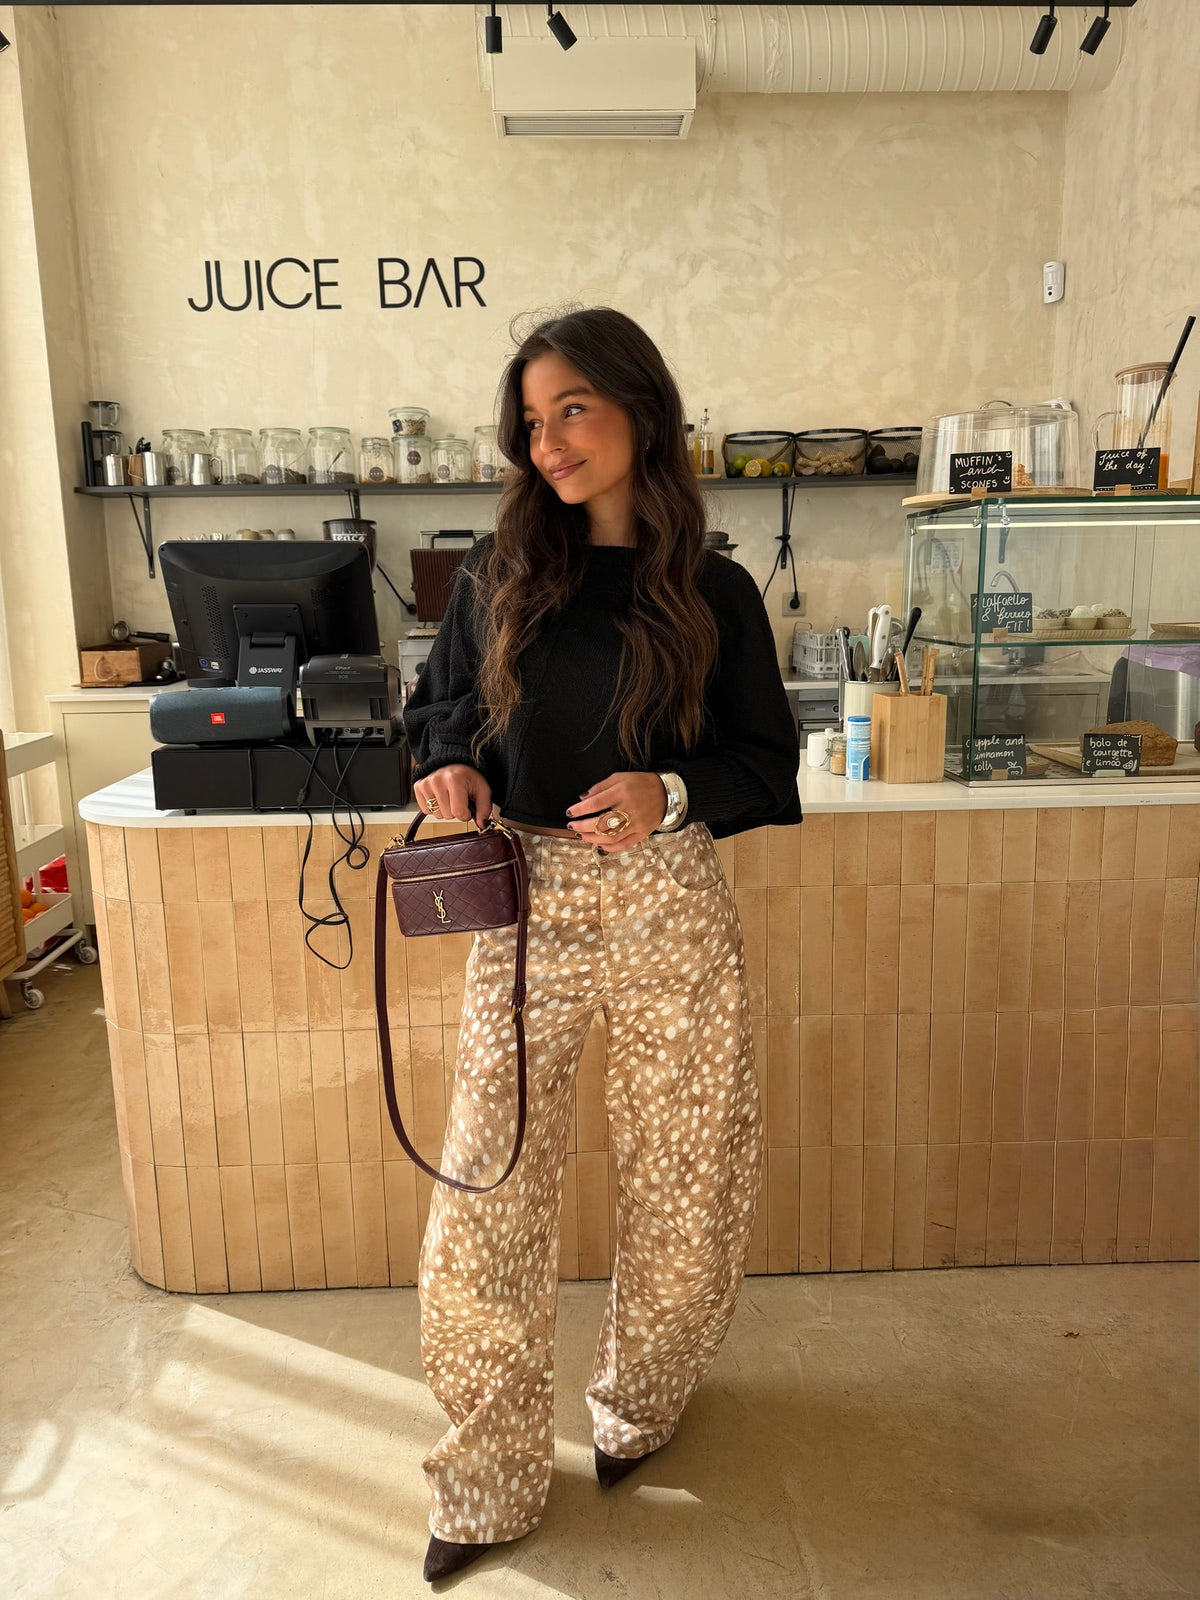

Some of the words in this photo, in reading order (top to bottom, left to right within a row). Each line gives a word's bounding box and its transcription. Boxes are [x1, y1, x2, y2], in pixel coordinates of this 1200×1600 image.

[187, 257, 342, 312] JUICE
[377, 256, 487, 309] BAR
[1099, 450, 1130, 466] juice
[1136, 449, 1148, 459] of
[960, 464, 1004, 477] and
[1102, 460, 1118, 471] the
[960, 480, 998, 489] SCONES
[981, 607, 991, 622] &
[1005, 735, 1024, 746] and
[1089, 736, 1112, 749] bolo
[1117, 738, 1128, 748] de
[1085, 759, 1092, 767] e
[433, 889, 452, 923] YSL
